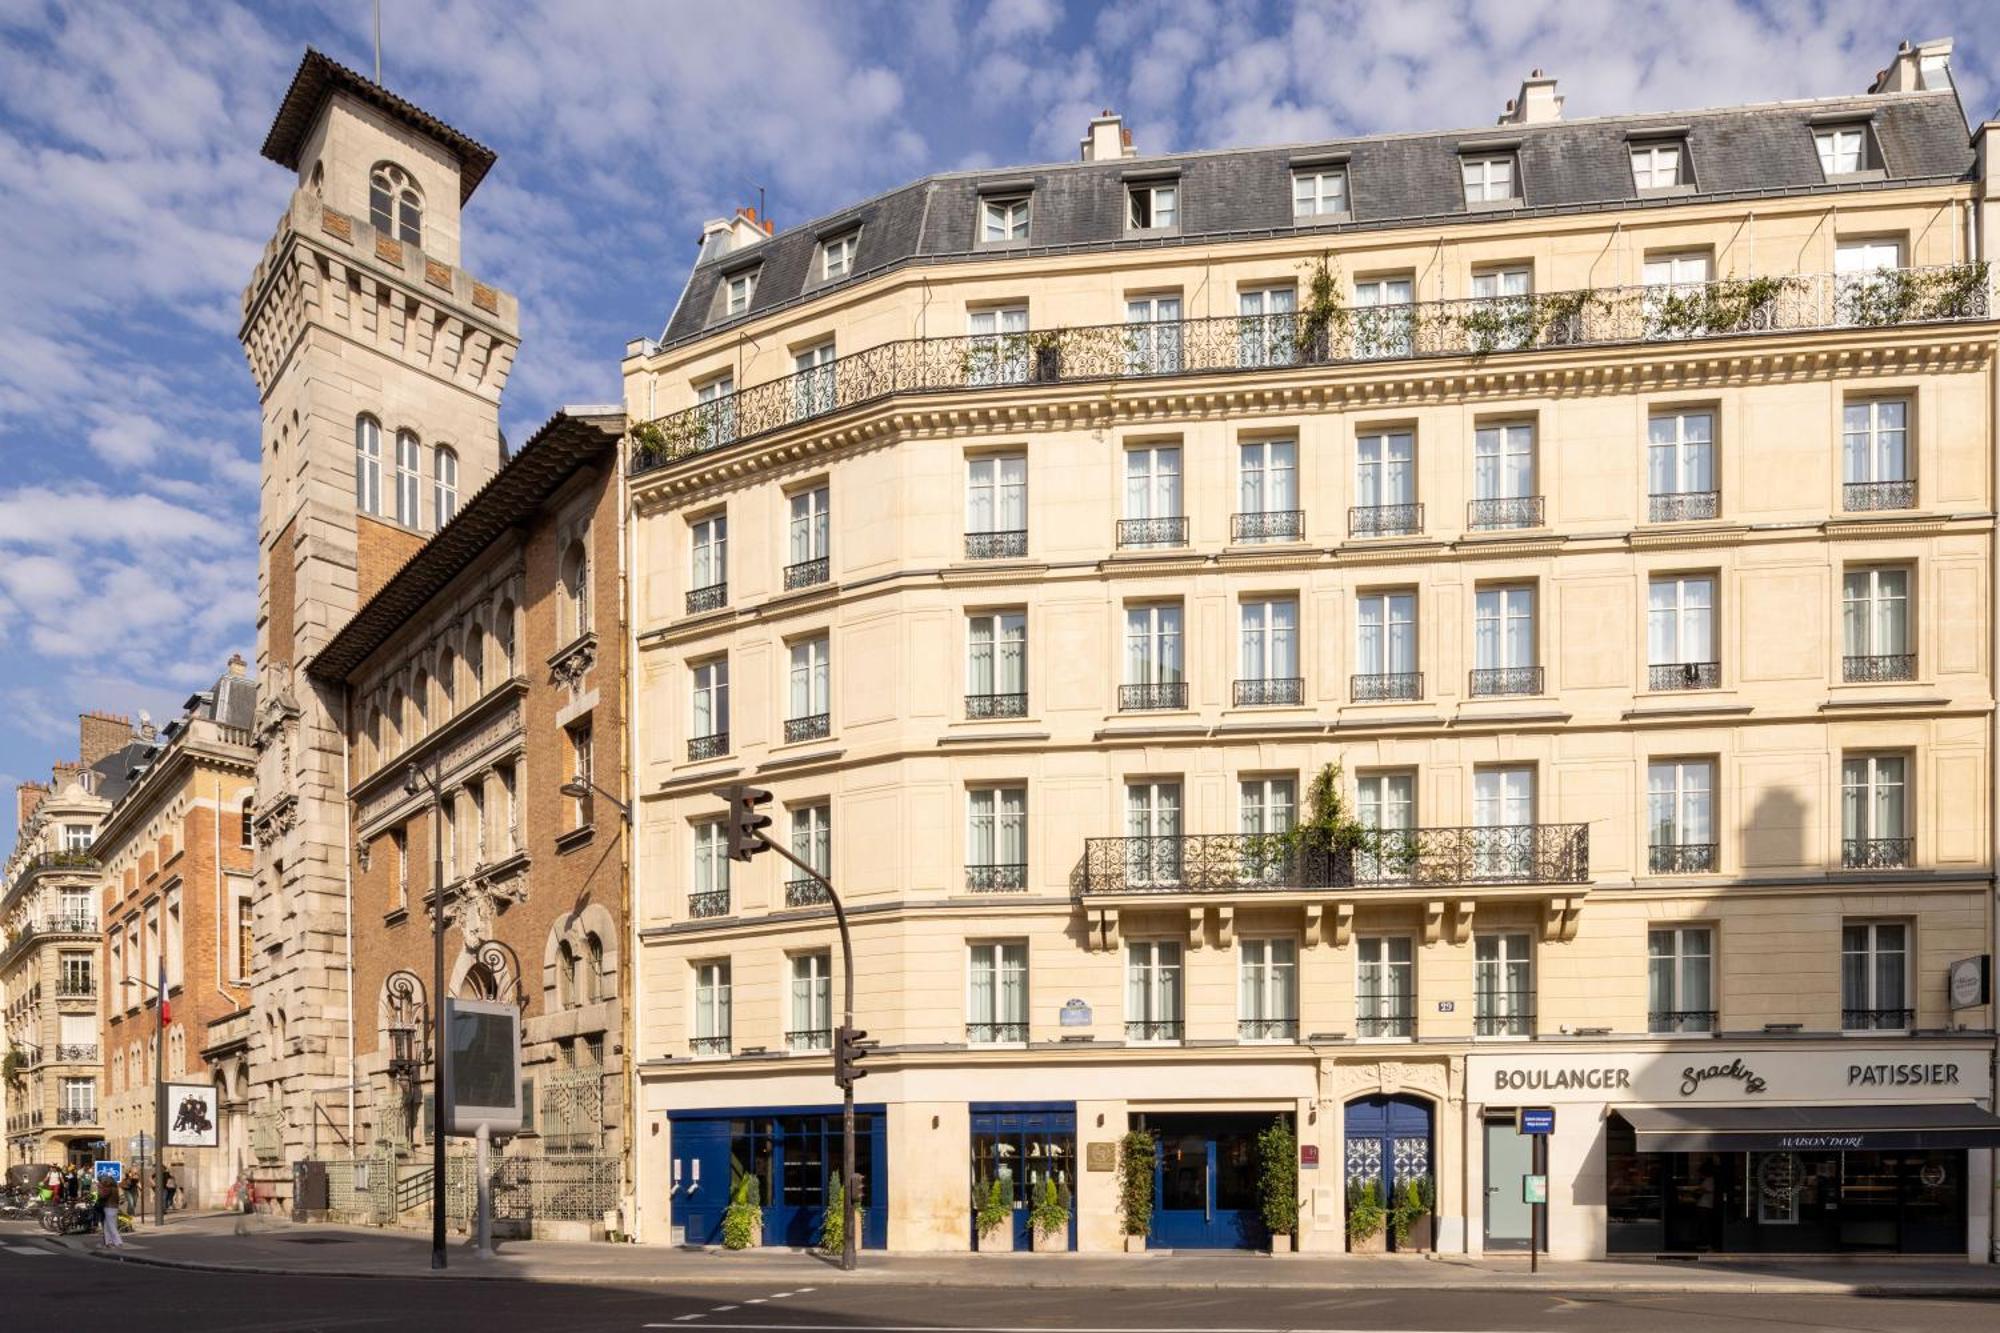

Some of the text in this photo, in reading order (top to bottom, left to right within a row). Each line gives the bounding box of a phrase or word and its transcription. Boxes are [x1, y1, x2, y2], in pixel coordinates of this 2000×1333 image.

[1495, 1068, 1631, 1090] BOULANGER
[1680, 1058, 1767, 1096] Snacking
[1847, 1064, 1960, 1086] PATISSIER
[1780, 1137, 1829, 1147] MAISON
